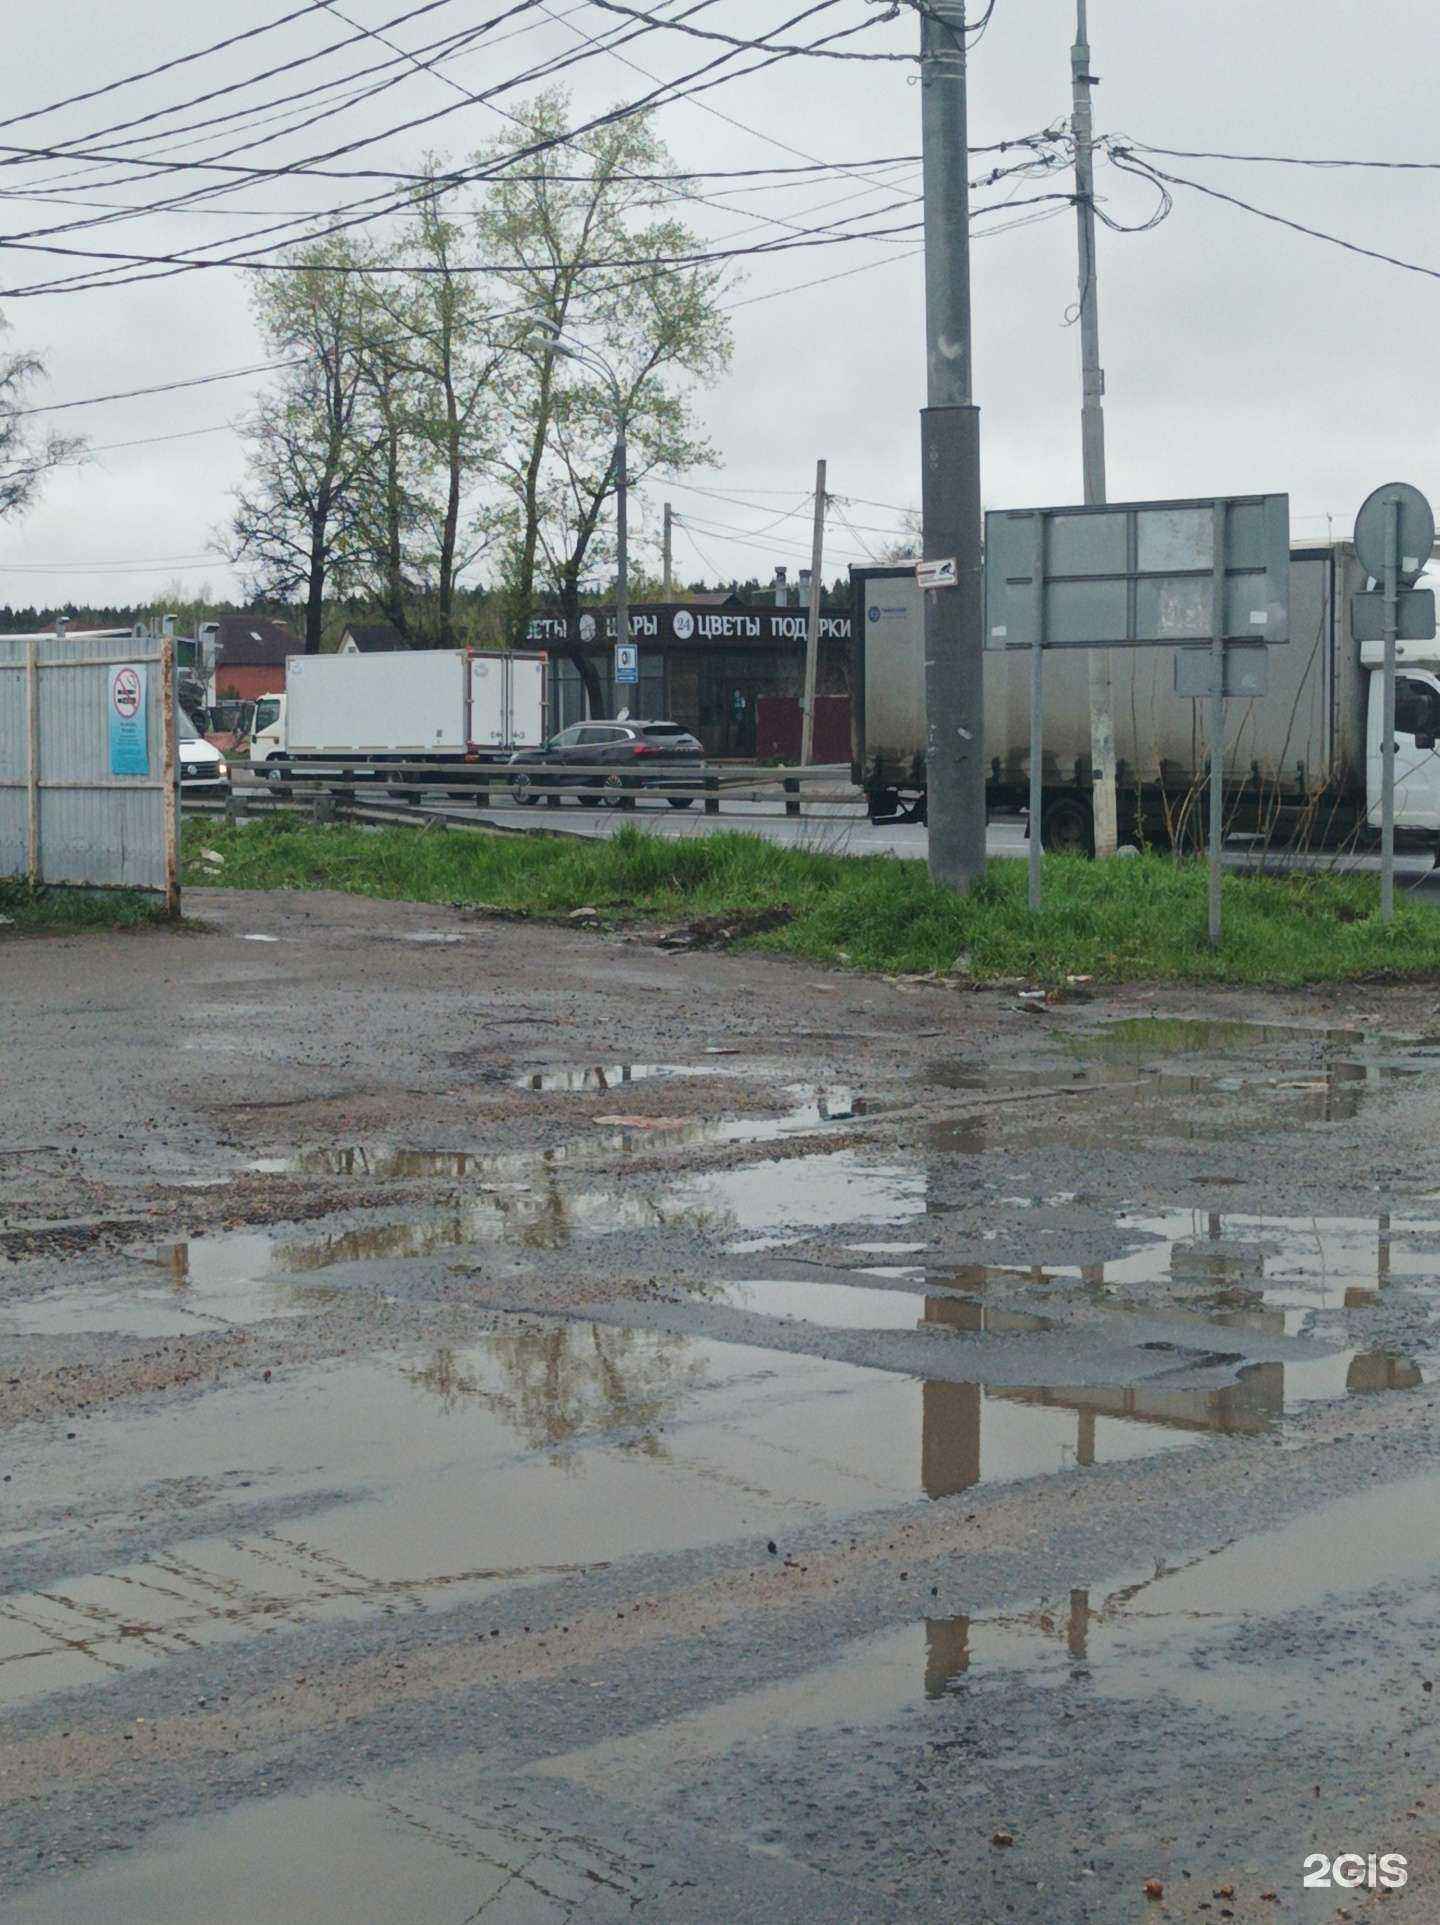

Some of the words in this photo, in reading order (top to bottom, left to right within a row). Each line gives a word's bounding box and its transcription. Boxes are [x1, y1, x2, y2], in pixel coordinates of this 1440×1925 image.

[606, 615, 658, 637] ШРЫ
[697, 615, 760, 640] ЦВЕТЫ
[771, 617, 852, 642] ПОДРКИ
